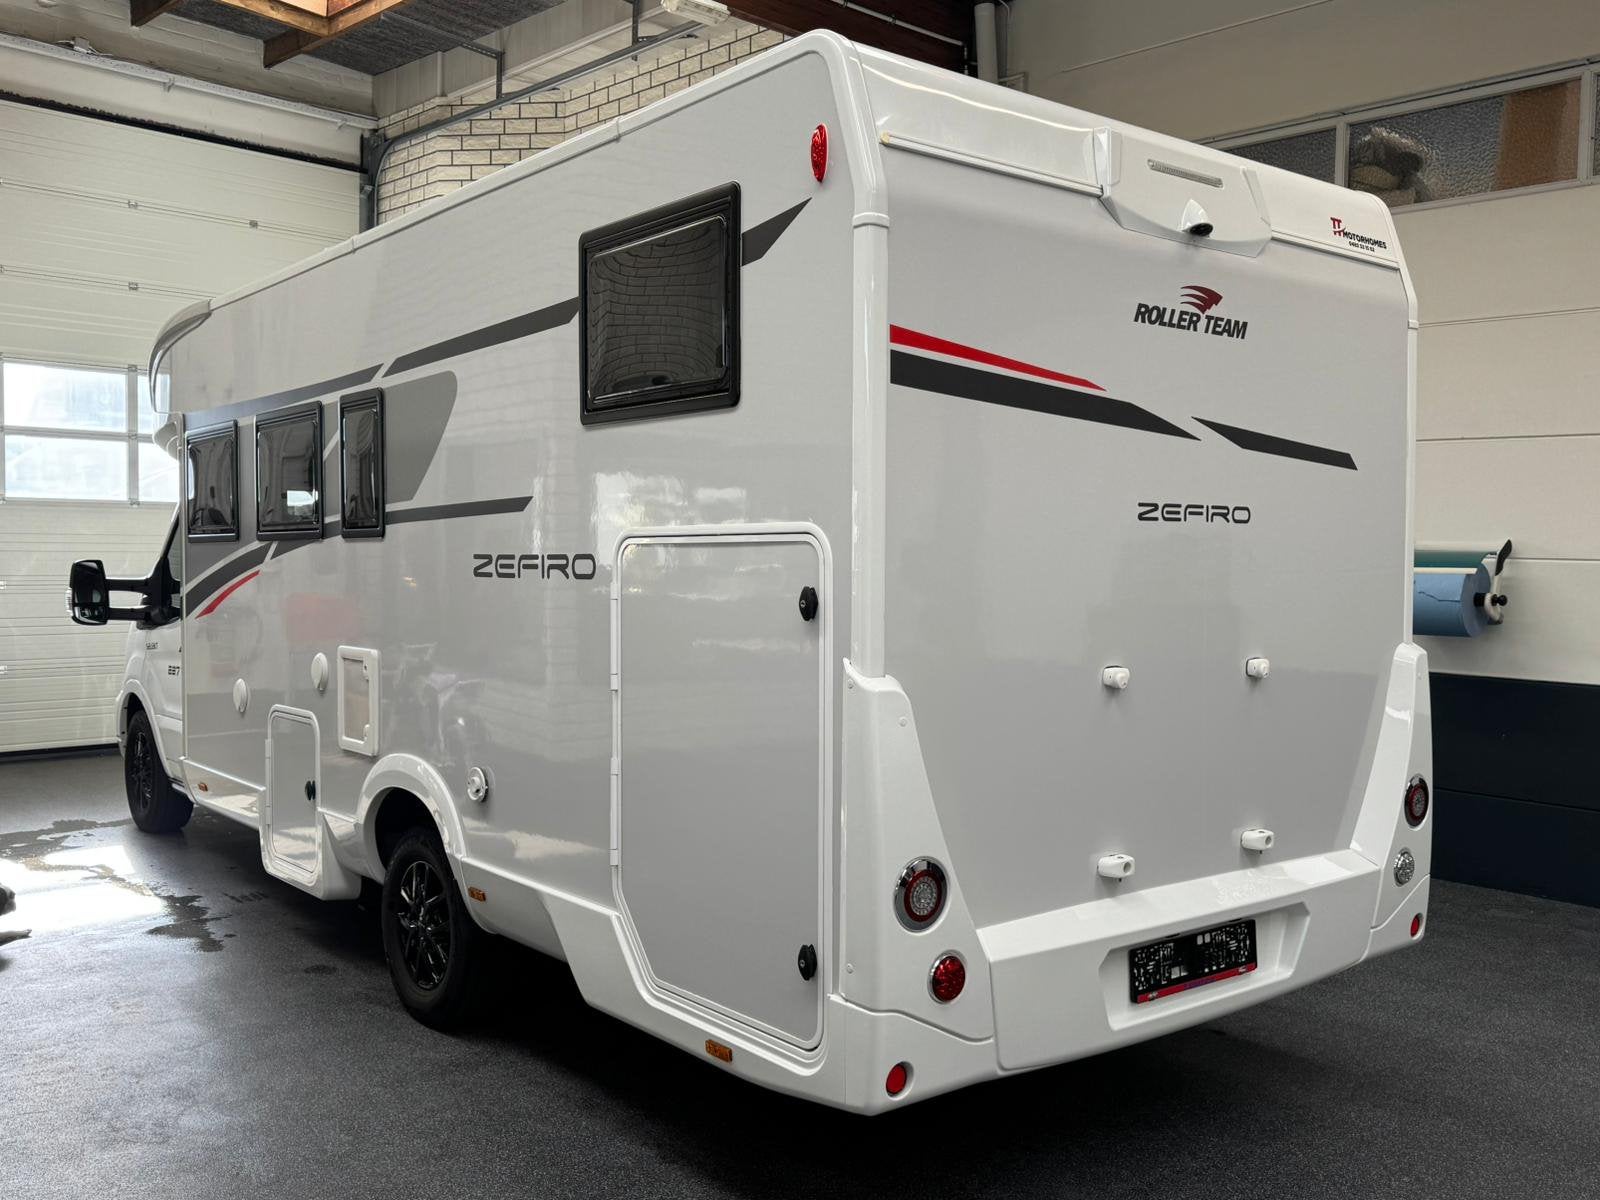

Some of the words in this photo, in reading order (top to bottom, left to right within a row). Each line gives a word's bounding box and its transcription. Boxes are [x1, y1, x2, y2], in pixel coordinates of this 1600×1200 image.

[1343, 231, 1387, 249] MOTORHOMES
[1133, 303, 1201, 332] ROLLER
[1204, 315, 1249, 340] TEAM
[1137, 502, 1251, 524] ZEFIRO
[472, 553, 597, 580] ZEFIRO
